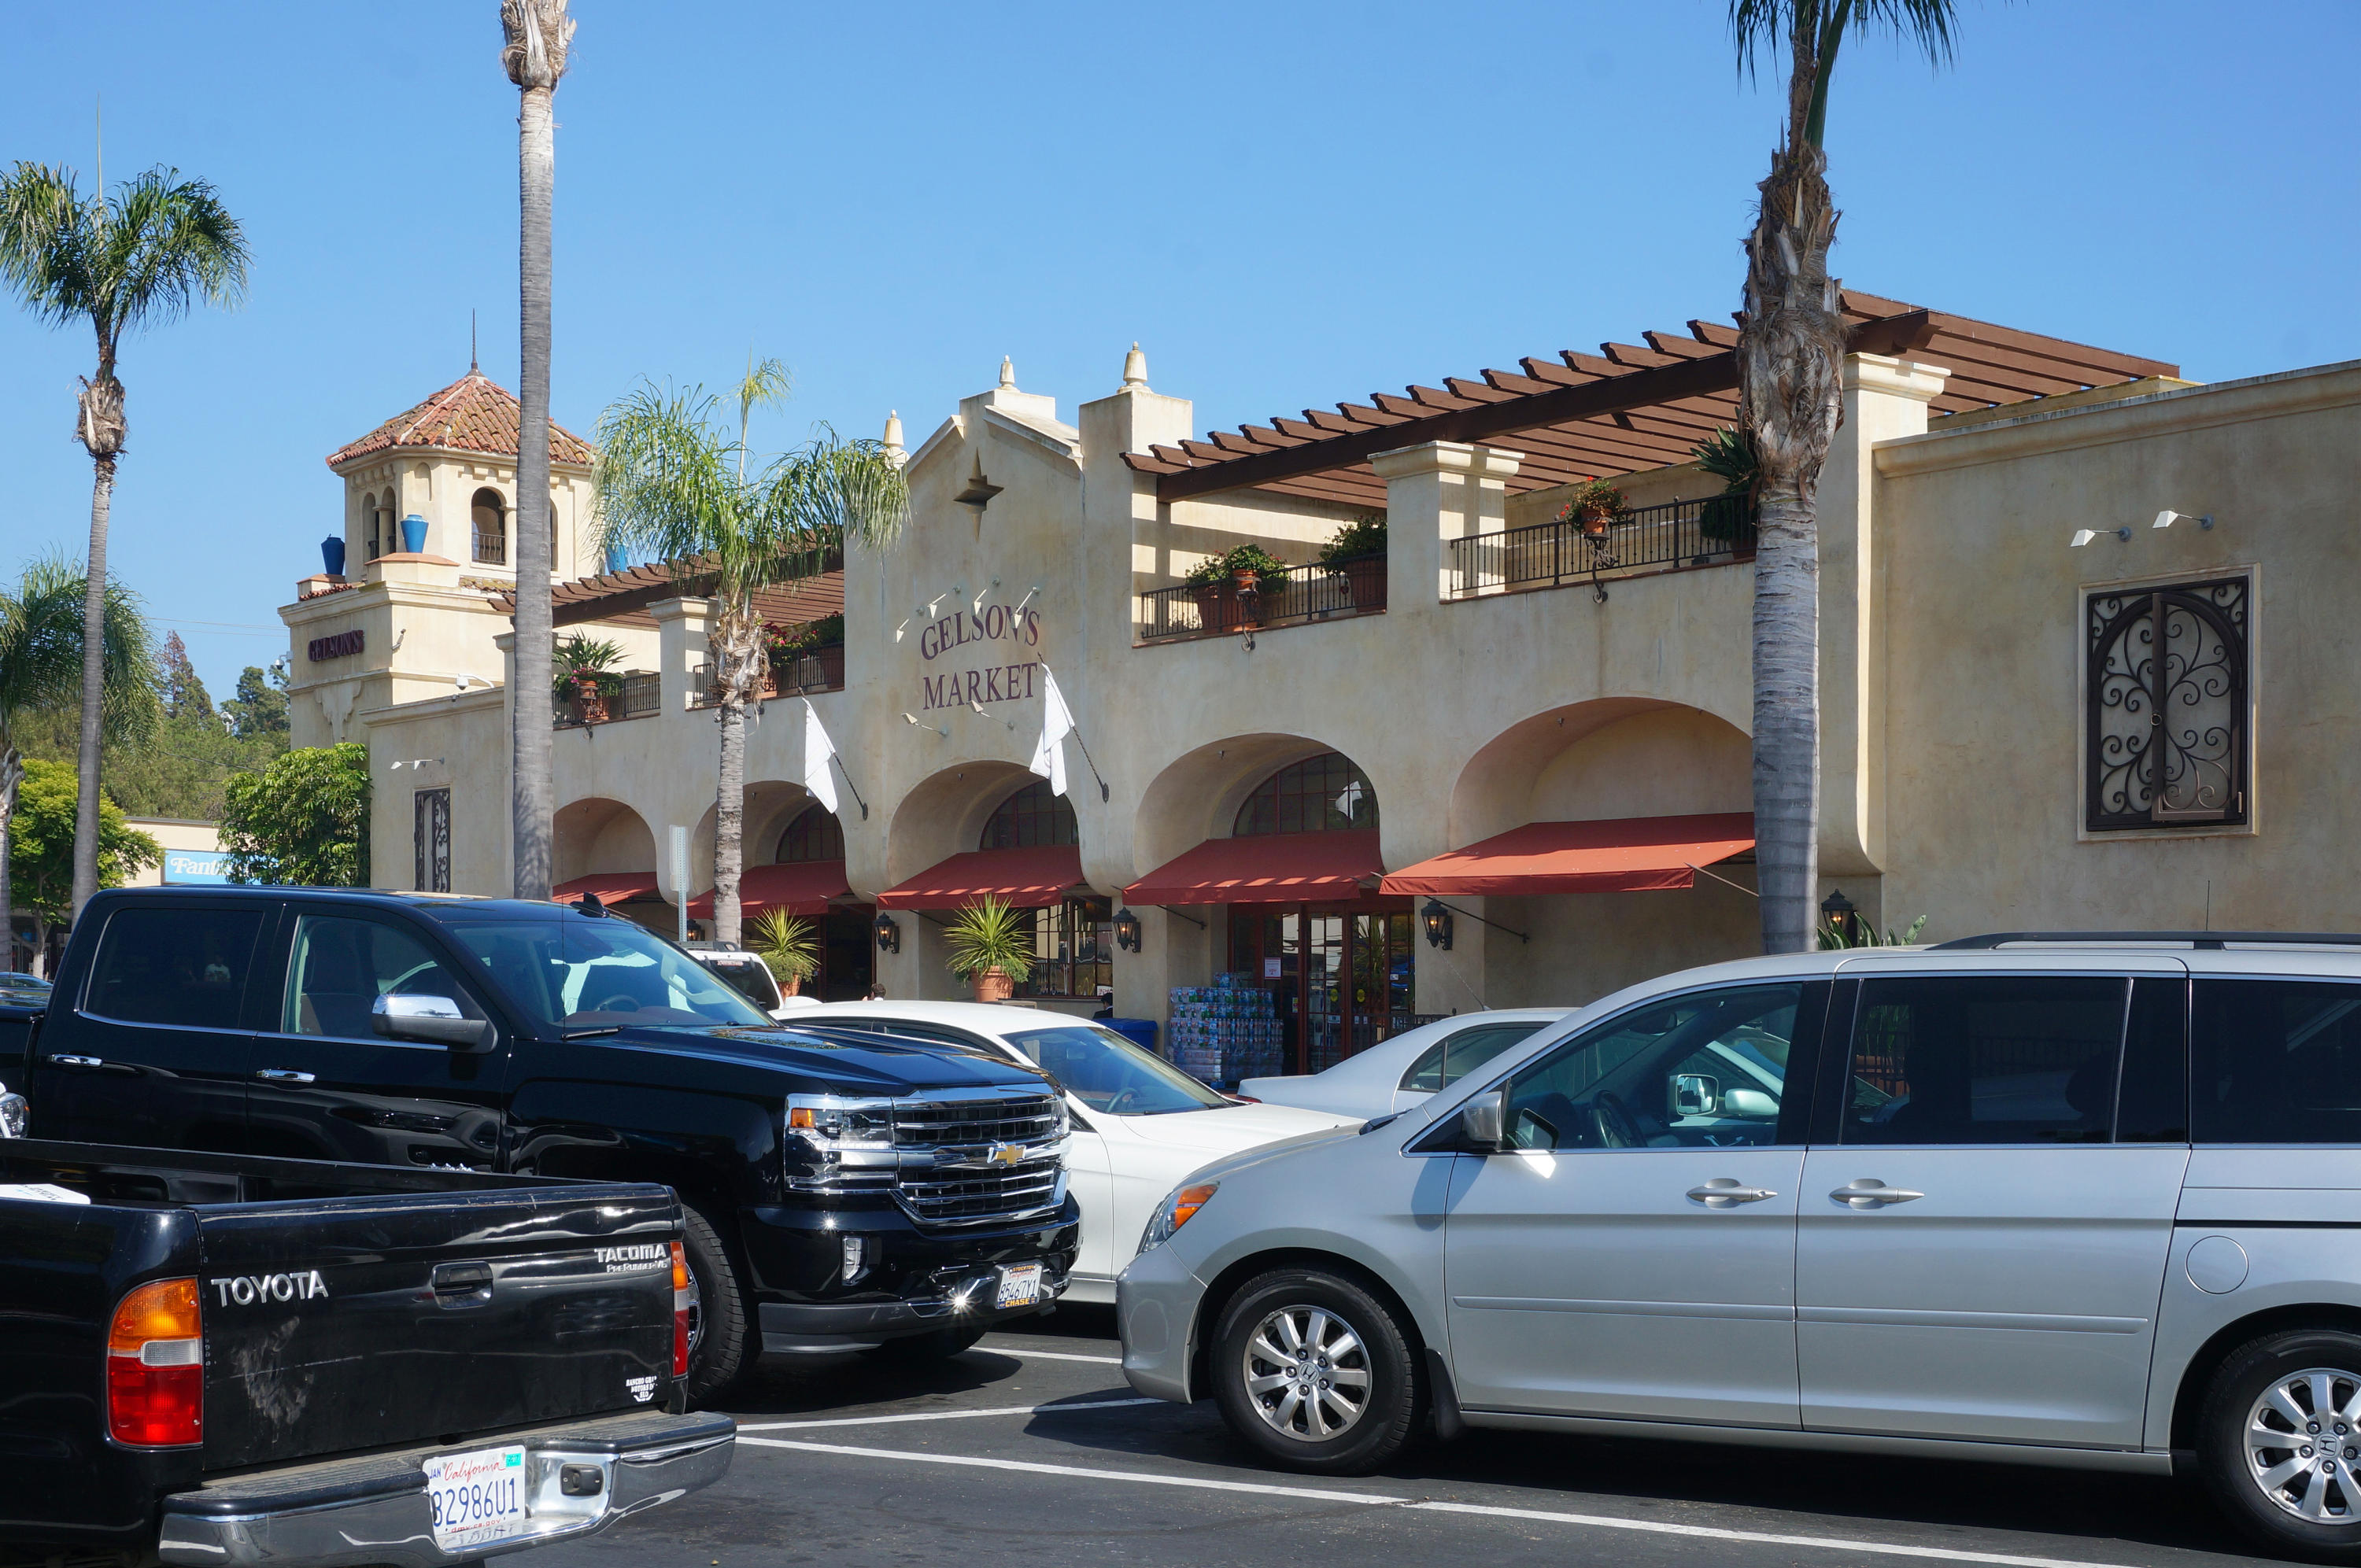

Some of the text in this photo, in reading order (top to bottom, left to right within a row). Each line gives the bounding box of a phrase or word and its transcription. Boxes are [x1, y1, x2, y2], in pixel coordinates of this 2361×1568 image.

[921, 605, 1040, 660] GELSON'S
[923, 662, 1038, 710] MARKET
[210, 1270, 329, 1308] TOYOTA
[999, 1279, 1036, 1301] 85467Y1
[1005, 1297, 1030, 1308] CHASE
[429, 1467, 442, 1479] JAN
[444, 1459, 507, 1483] California
